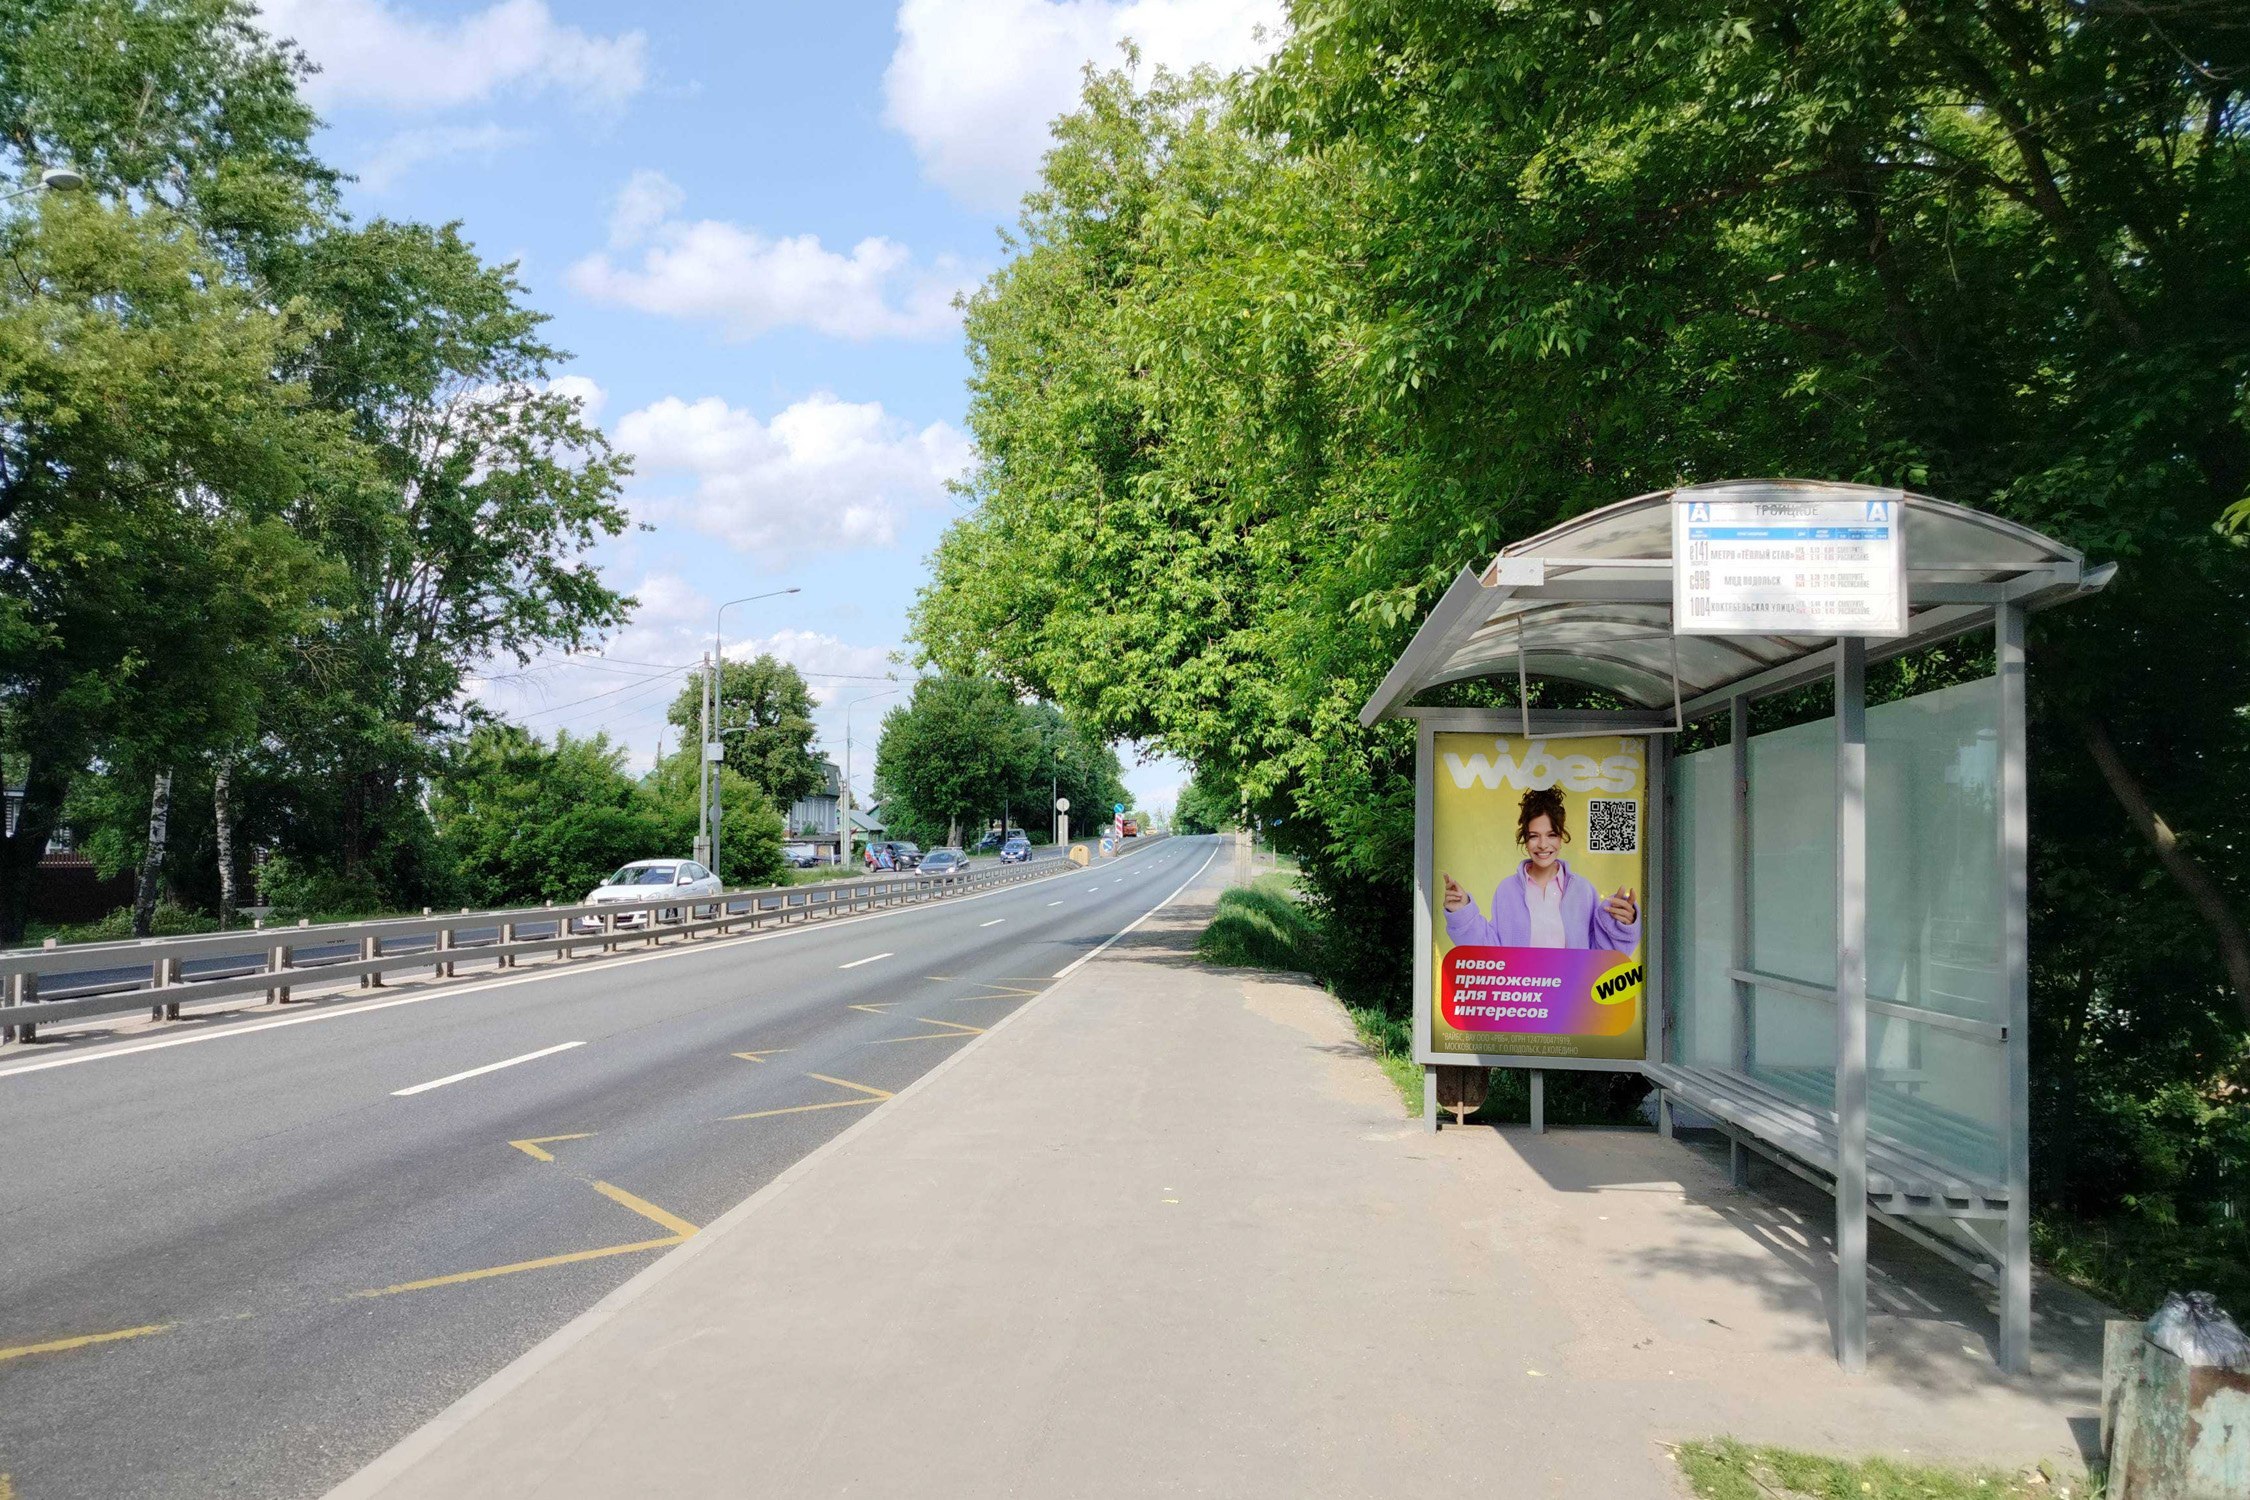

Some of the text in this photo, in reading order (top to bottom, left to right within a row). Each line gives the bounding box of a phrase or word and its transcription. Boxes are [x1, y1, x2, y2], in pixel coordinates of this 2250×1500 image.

[1443, 739, 1639, 793] wibes
[1455, 959, 1506, 970] новое
[1455, 974, 1562, 988] приложение
[1596, 965, 1644, 1000] WOW
[1453, 990, 1542, 1003] для твоих
[1454, 1005, 1549, 1021] интересов
